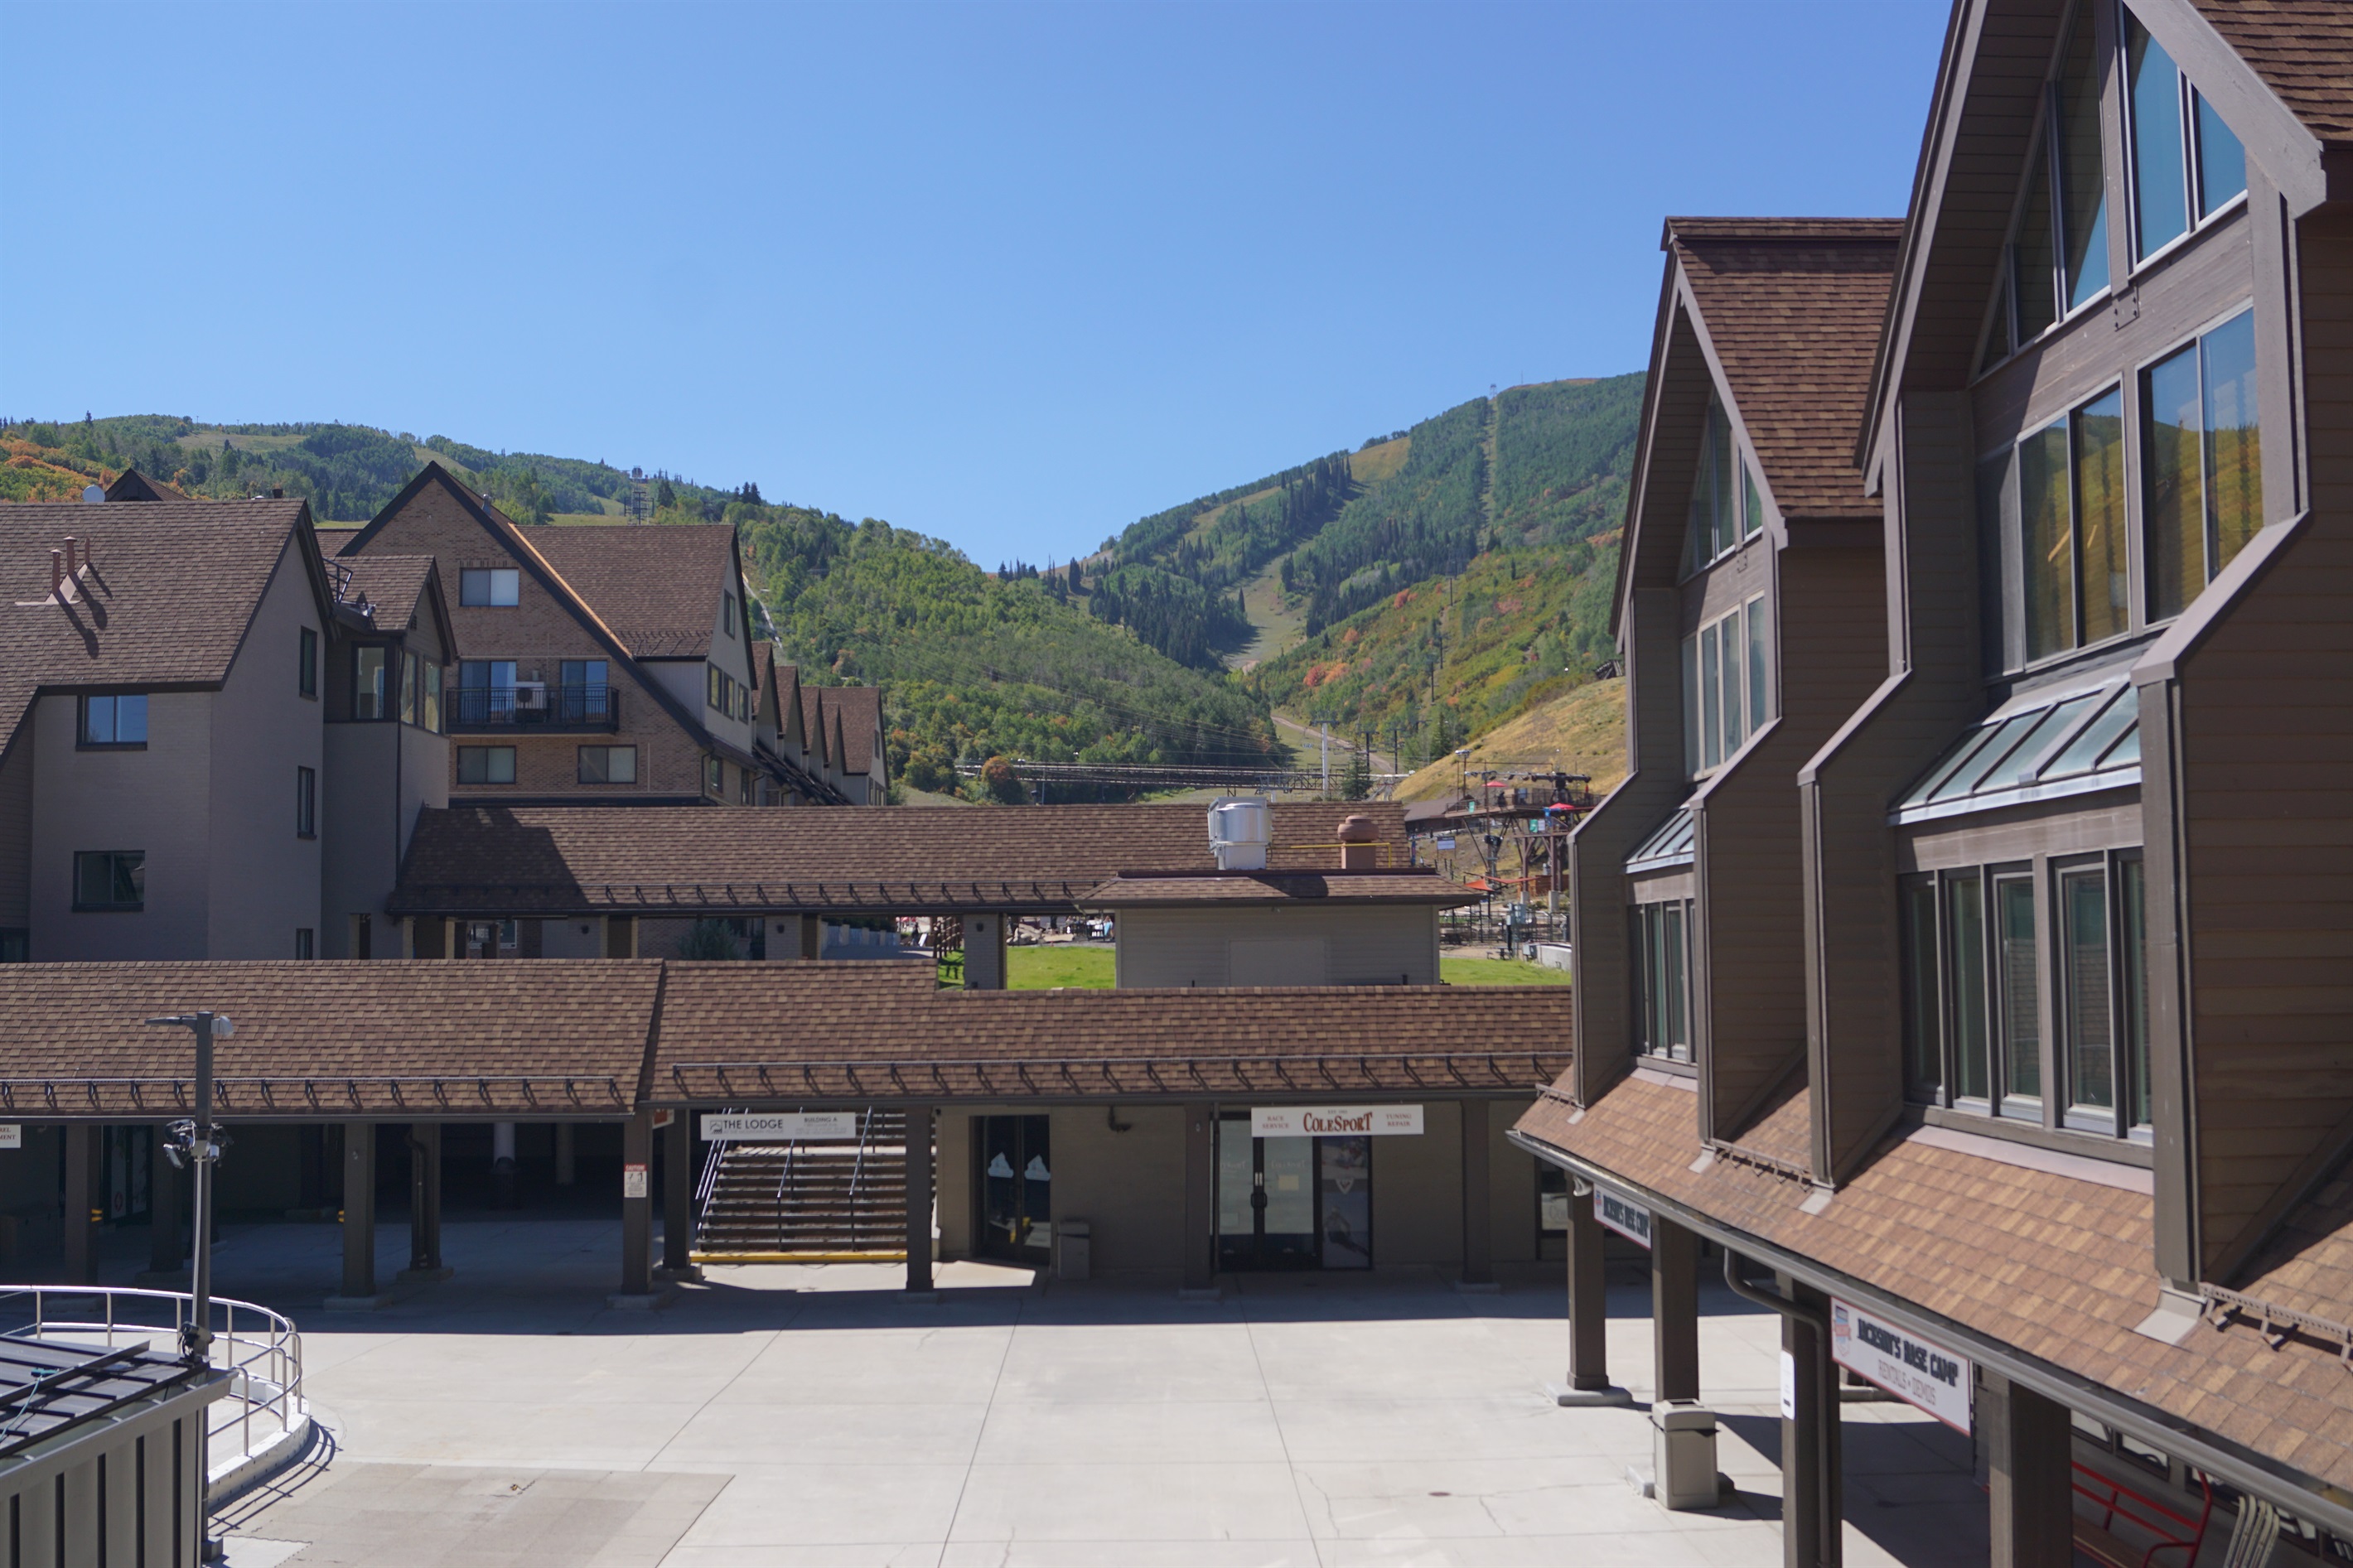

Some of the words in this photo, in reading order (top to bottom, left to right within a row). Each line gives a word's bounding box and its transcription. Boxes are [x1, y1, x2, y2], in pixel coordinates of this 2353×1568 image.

[723, 1120, 742, 1130] THE
[745, 1119, 783, 1129] LODGE
[1878, 1359, 1906, 1390] RENTALS
[1911, 1377, 1936, 1406] DEMOS
[1903, 1339, 1928, 1373] BASE
[1930, 1353, 1958, 1387] CAMP
